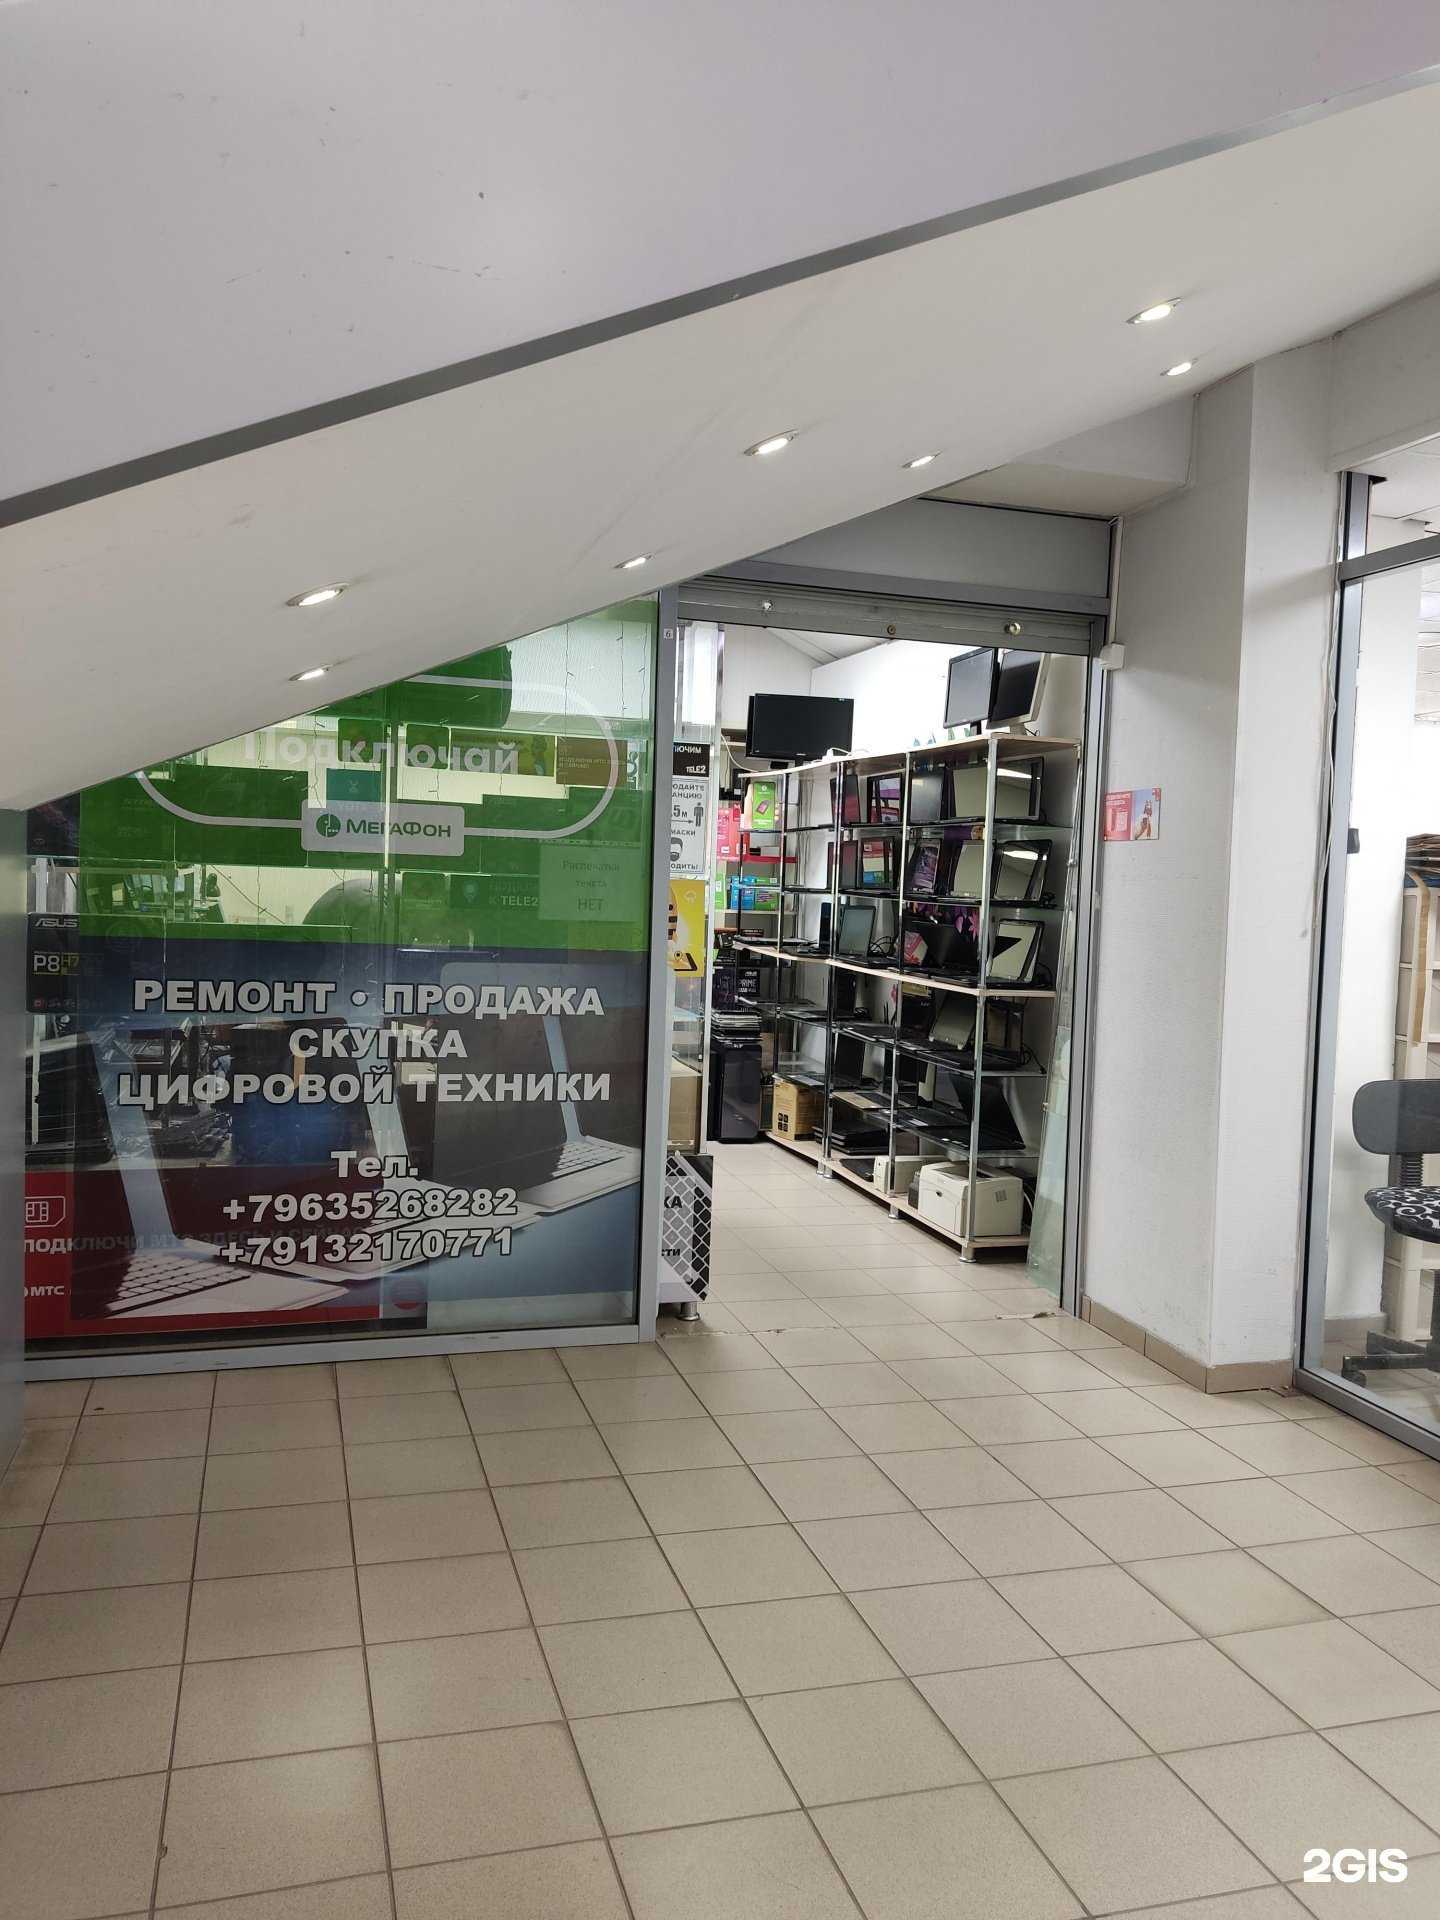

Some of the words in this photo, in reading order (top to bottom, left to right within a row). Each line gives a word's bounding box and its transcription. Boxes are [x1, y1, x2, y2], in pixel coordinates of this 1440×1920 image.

[245, 733, 518, 775] Подключай
[577, 897, 604, 911] НЕТ
[35, 918, 79, 928] ASUS
[134, 979, 337, 1013] РЕМОНТ
[384, 983, 605, 1020] ПРОДАЖА
[289, 1028, 468, 1059] СКУПКА
[118, 1066, 393, 1111] ЦИФРОВОЙ
[408, 1073, 611, 1103] ТЕХНИКИ
[330, 1150, 418, 1178] Тел.
[222, 1187, 518, 1223] +79635268282
[220, 1227, 513, 1265] +79132170771
[30, 1285, 65, 1297] МТС
